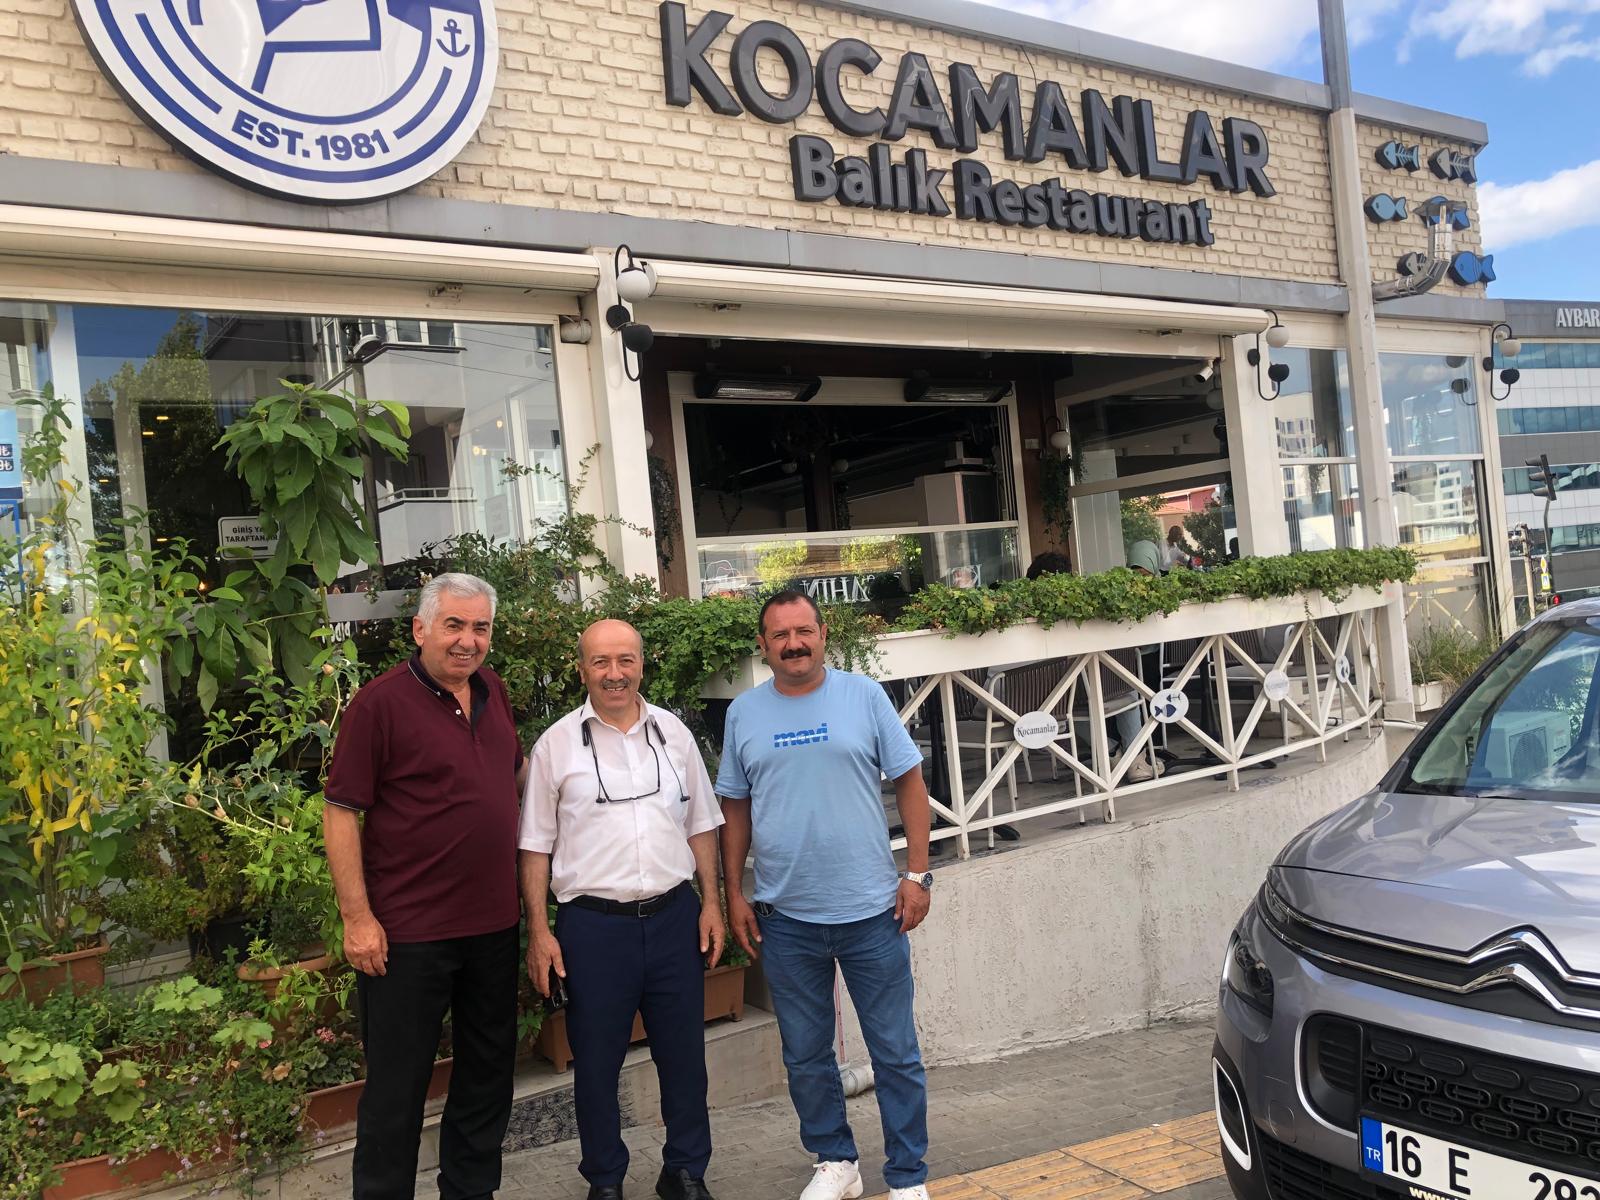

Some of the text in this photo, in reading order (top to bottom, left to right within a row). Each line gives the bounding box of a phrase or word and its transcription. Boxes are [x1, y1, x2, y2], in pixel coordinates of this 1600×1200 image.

[659, 0, 1277, 197] KOCAMANLAR
[231, 109, 390, 161] EST. 1981
[789, 135, 1215, 247] Balık Restaurant
[774, 722, 829, 748] mavi
[1366, 1146, 1381, 1162] TR
[1386, 1130, 1422, 1178] 16
[1448, 1147, 1471, 1195] E
